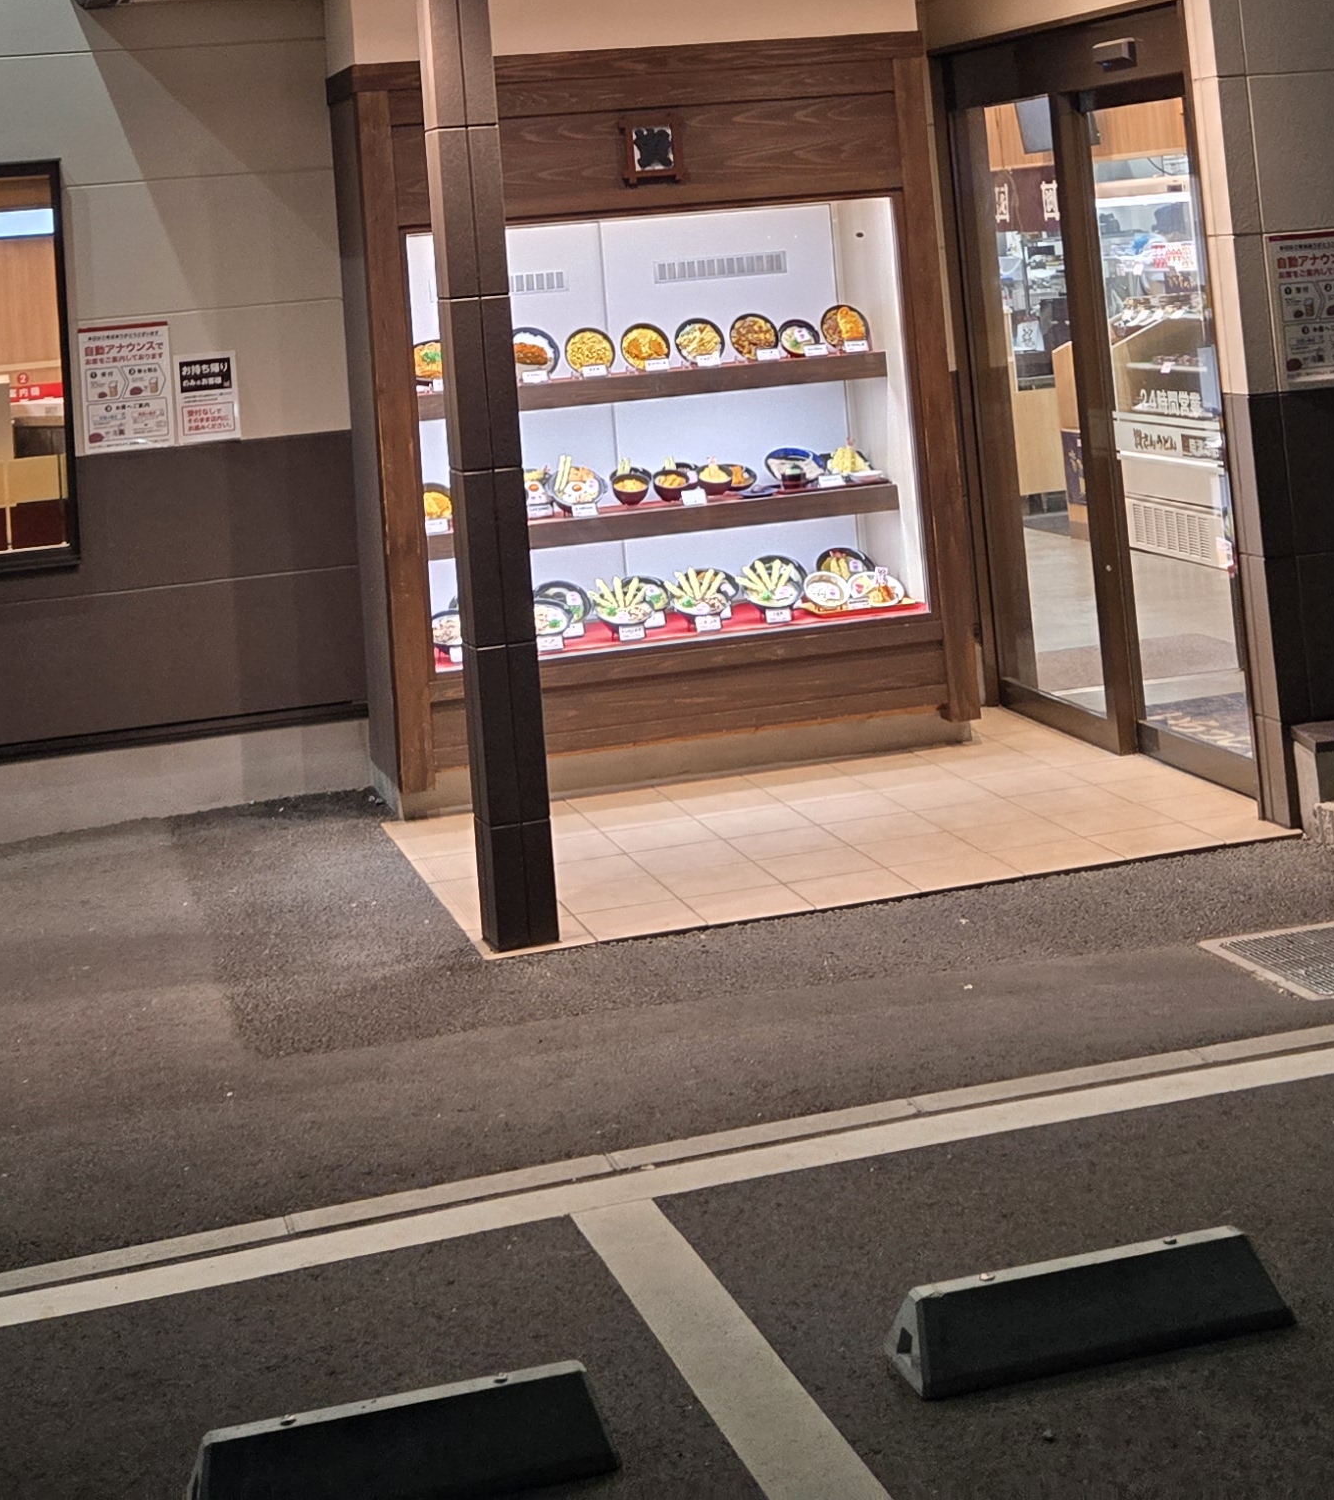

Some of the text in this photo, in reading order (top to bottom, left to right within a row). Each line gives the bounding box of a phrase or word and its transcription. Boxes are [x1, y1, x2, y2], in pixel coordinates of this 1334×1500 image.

[84, 341, 163, 357] 自動アナウンスで
[182, 362, 227, 376] お持ち帰り
